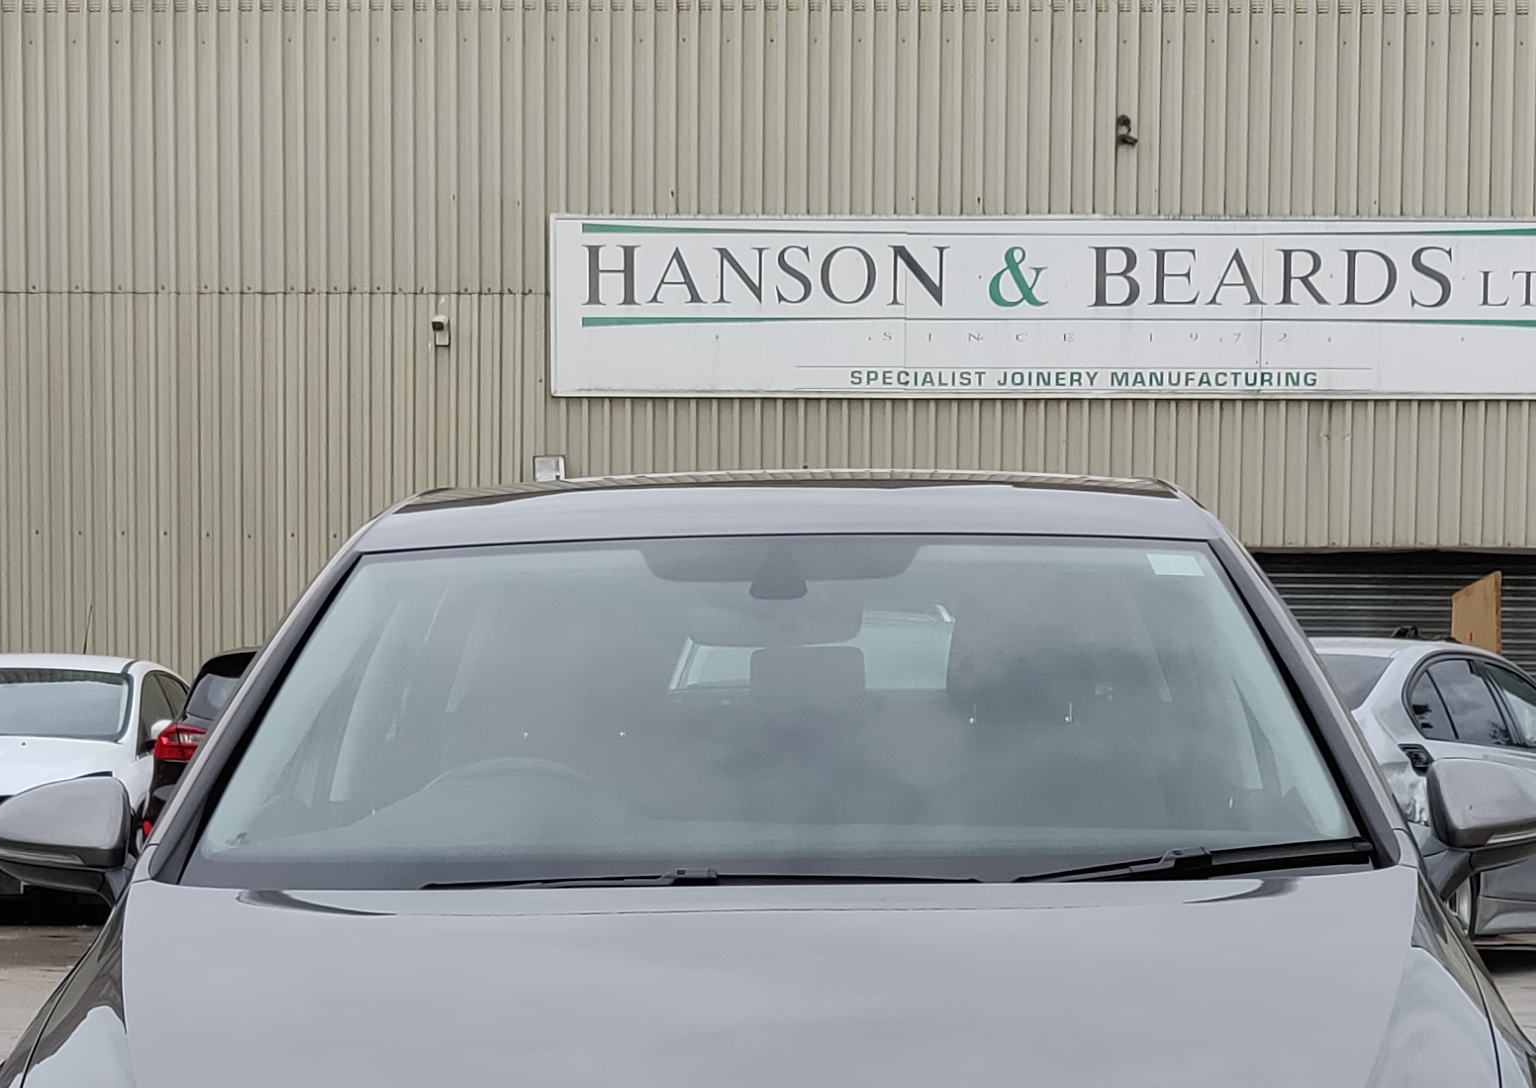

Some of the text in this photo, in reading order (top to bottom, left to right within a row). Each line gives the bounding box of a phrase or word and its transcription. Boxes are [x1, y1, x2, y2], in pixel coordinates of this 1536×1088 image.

[581, 244, 951, 307] HANSON
[988, 246, 1049, 308] &
[1087, 246, 1454, 308] BEARDS
[850, 370, 1319, 388] SPECIALIST JOINERY MANUFACTURING
